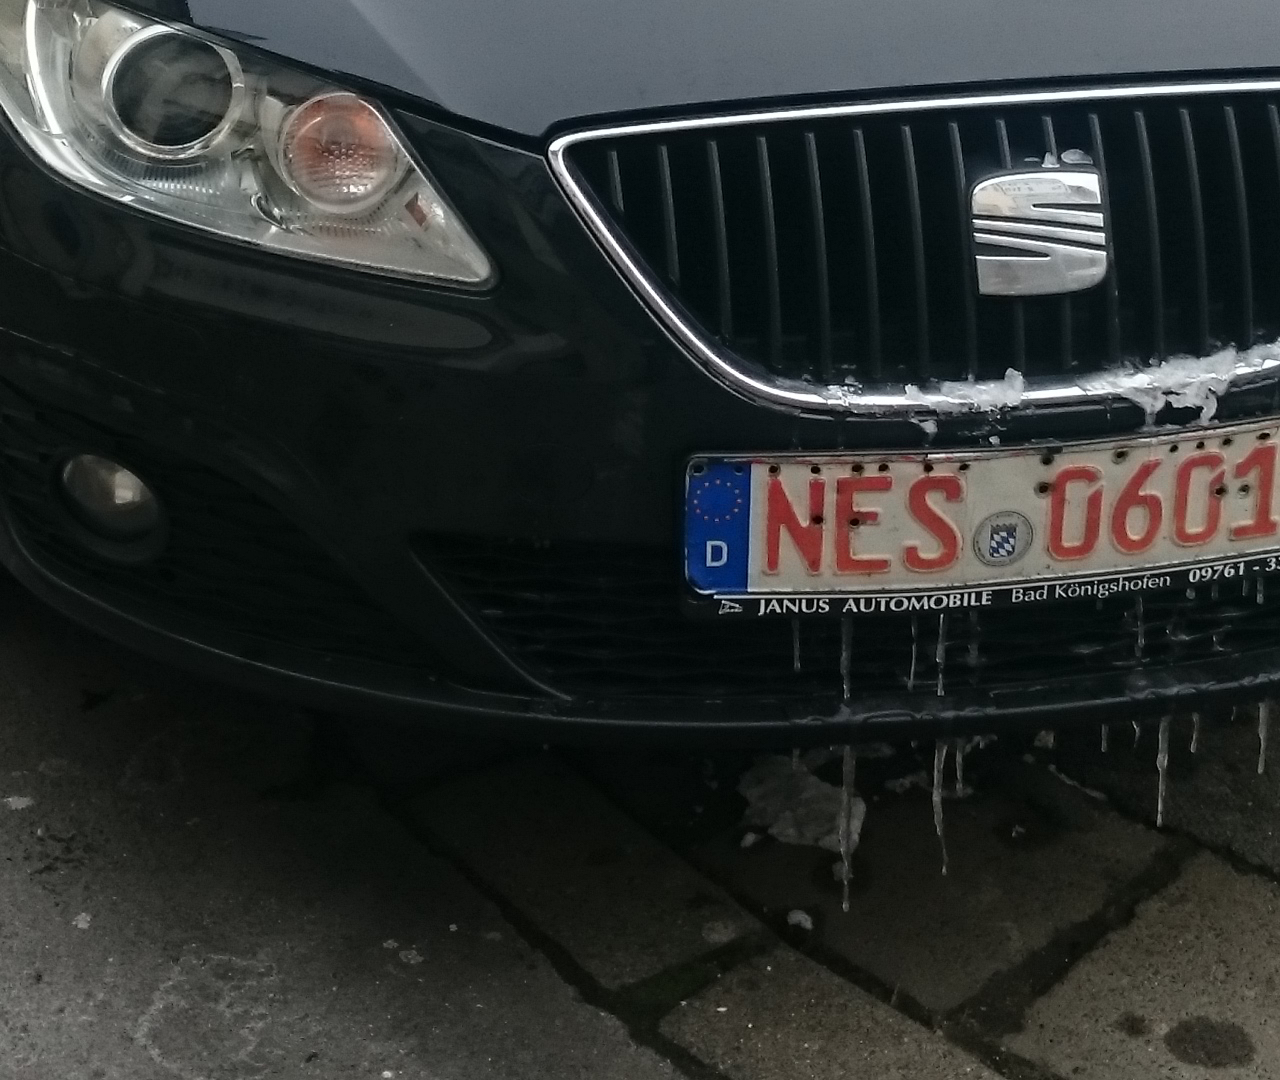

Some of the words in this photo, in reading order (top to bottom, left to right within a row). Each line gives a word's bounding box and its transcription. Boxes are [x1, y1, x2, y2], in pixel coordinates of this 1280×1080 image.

[765, 475, 964, 576] NES
[705, 540, 728, 568] D
[757, 597, 830, 617] JANUS
[842, 590, 994, 613] AUTOMOBILE
[1011, 585, 1048, 604] Bad
[1054, 572, 1172, 601] Königshofen
[1188, 561, 1245, 584] 09761
